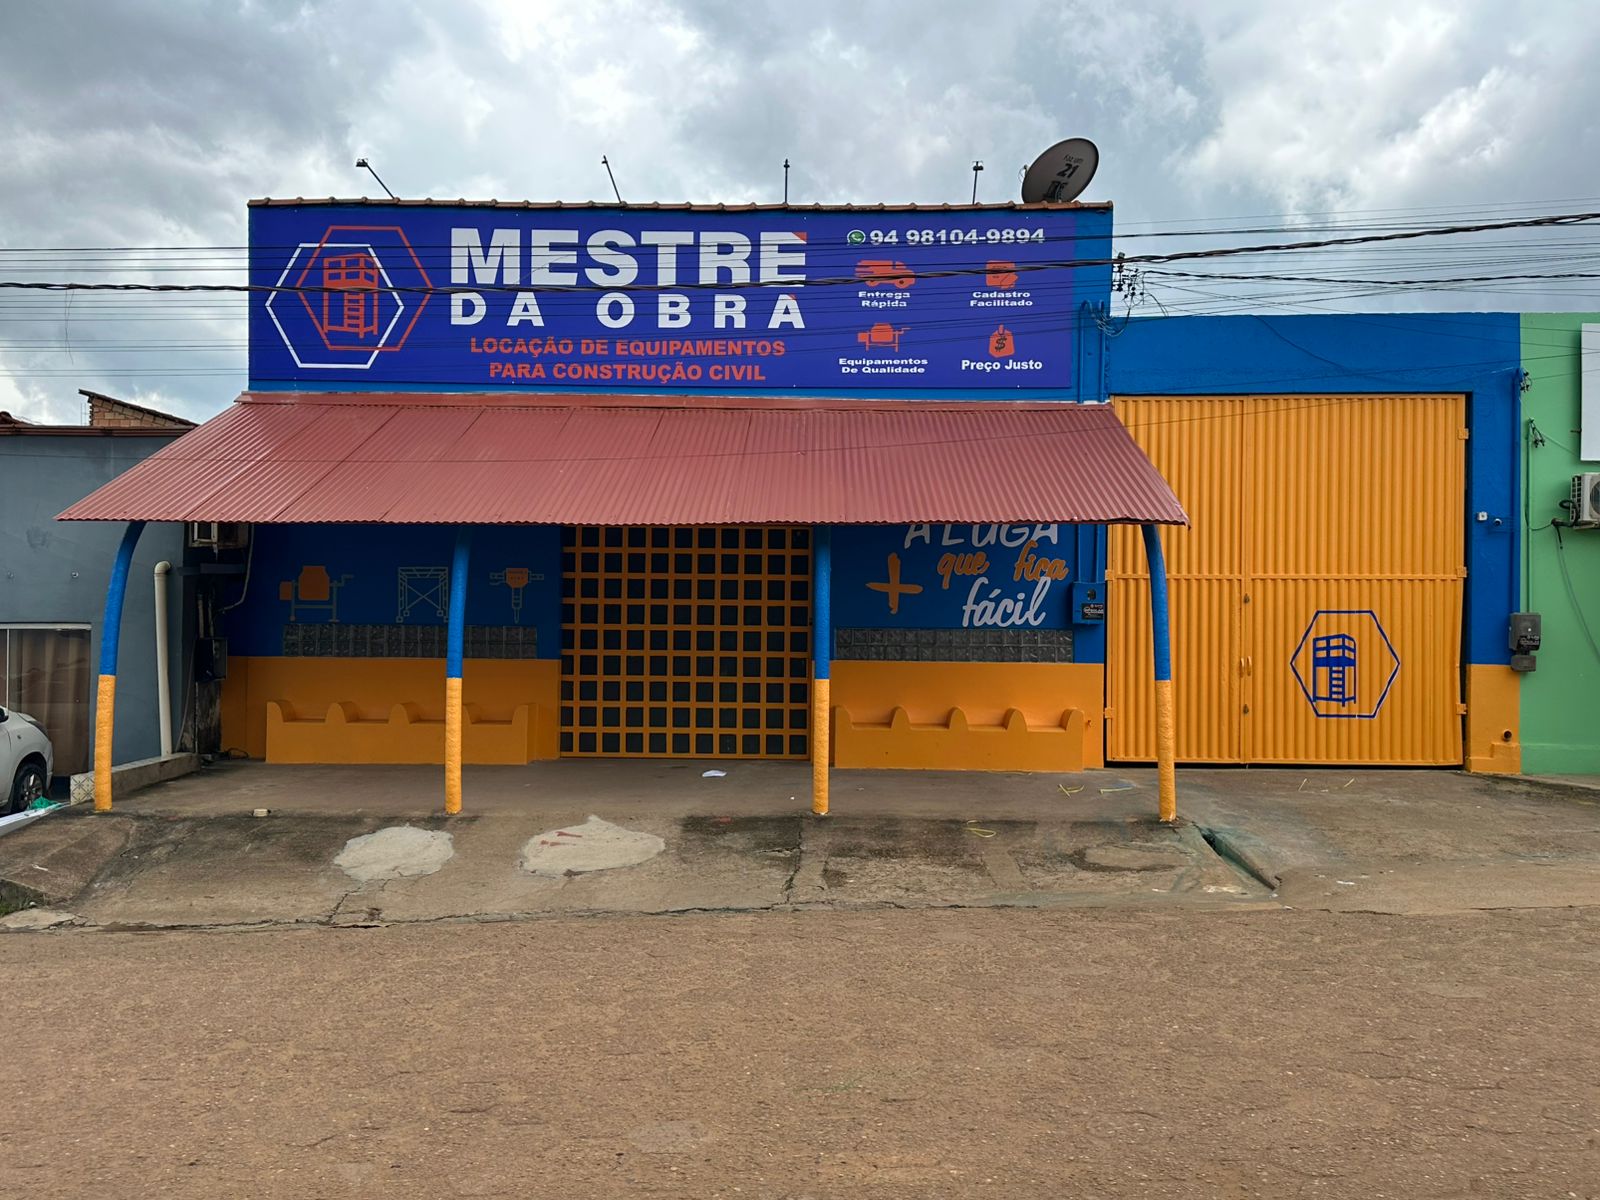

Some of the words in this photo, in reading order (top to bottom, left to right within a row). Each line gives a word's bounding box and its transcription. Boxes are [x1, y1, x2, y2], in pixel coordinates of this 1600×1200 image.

[869, 229, 899, 245] 94
[906, 228, 1045, 245] 98104-9894
[450, 228, 807, 287] MESTRE
[858, 291, 911, 299] Entrega
[861, 300, 907, 308] Rápida
[450, 291, 545, 327] DA
[596, 292, 806, 329] OBRA
[470, 336, 574, 358] LOCAÇÃO
[581, 339, 609, 355] DE
[616, 339, 786, 356] EQUIPAMENTOS
[838, 358, 928, 366] Equipamentos
[862, 366, 926, 374] Qualidade
[961, 359, 1001, 372] Preço
[1005, 359, 1043, 371] Justo
[489, 362, 547, 379] PARA
[553, 361, 702, 384] CONSTRUÇÃO
[709, 364, 766, 381] CIVIL
[936, 551, 990, 590] que
[1013, 540, 1069, 581] fica
[961, 576, 1052, 628] fácil
